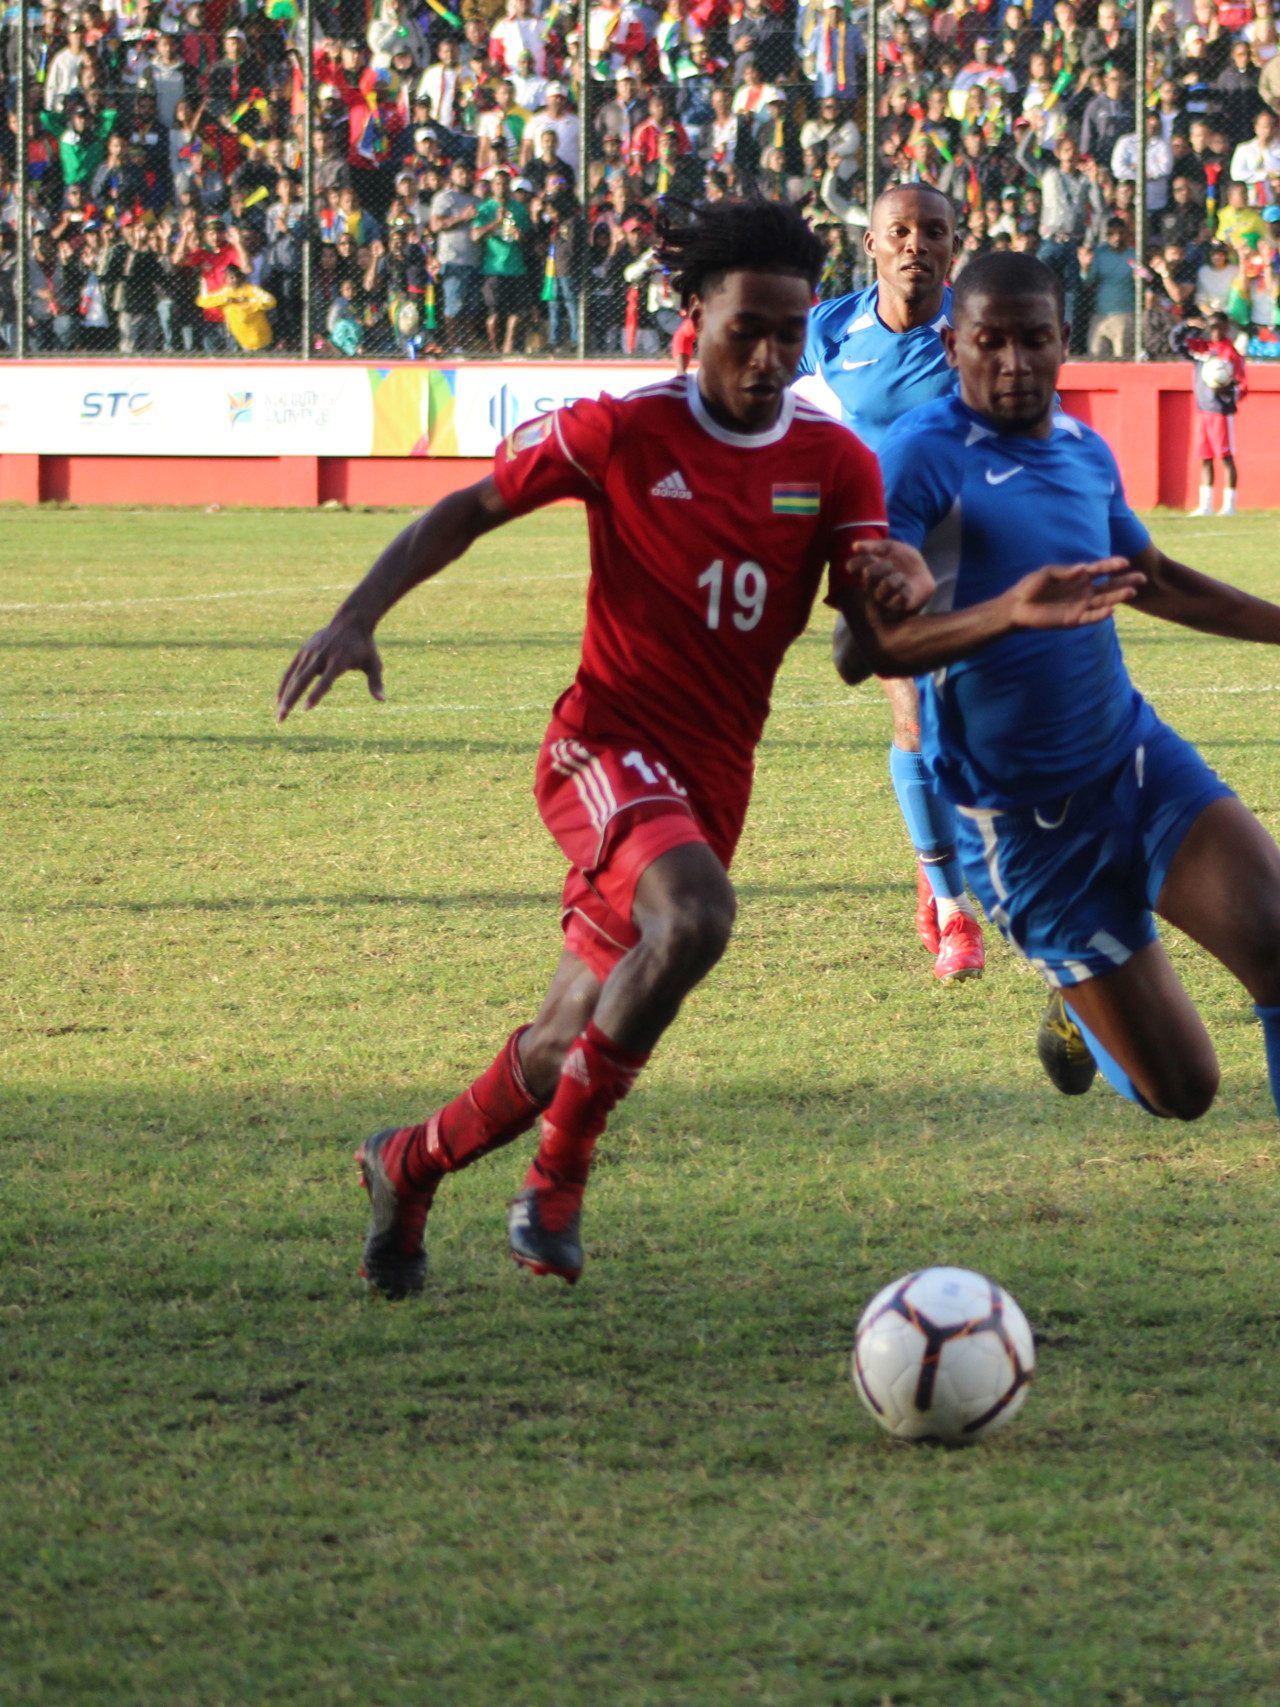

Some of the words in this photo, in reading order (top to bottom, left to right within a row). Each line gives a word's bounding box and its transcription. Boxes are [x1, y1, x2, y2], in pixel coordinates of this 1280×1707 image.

[79, 392, 154, 418] STC
[651, 487, 693, 500] adidas
[697, 558, 768, 631] 19
